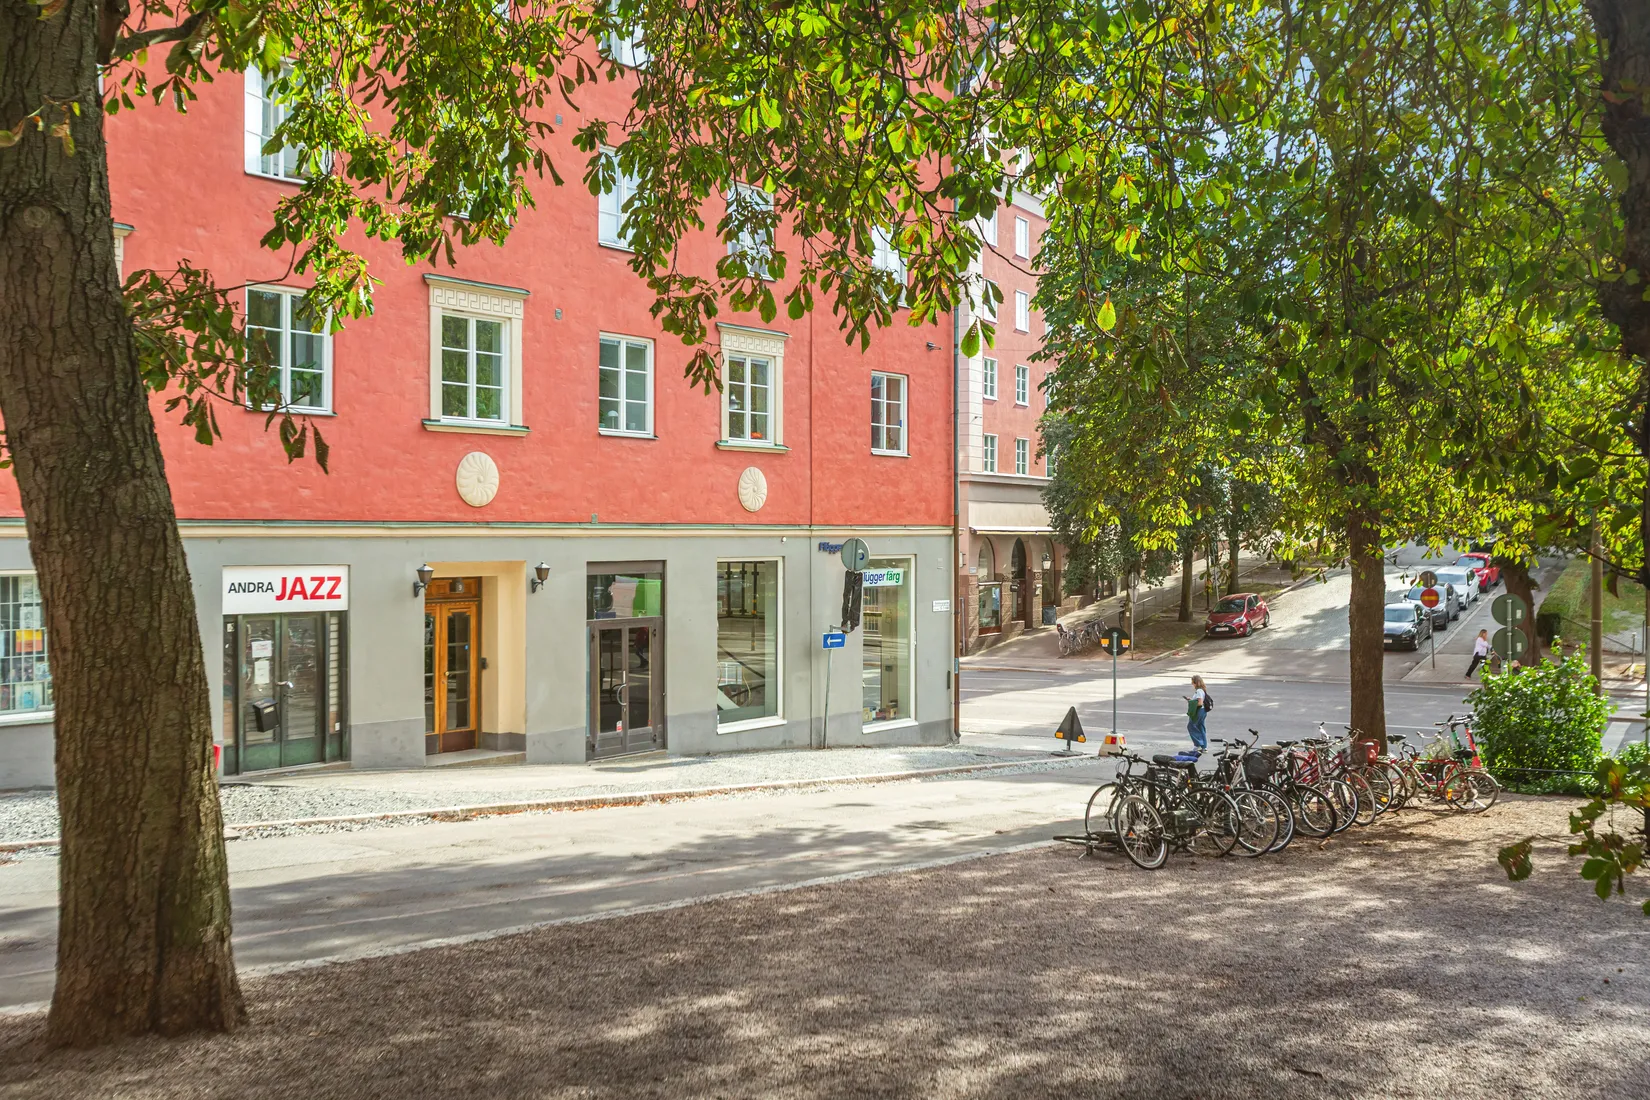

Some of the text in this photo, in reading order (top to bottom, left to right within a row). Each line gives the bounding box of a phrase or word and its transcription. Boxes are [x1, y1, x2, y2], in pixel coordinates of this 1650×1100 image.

[863, 571, 900, 584] lügger färg
[228, 576, 341, 601] ANDRA JAZZ
